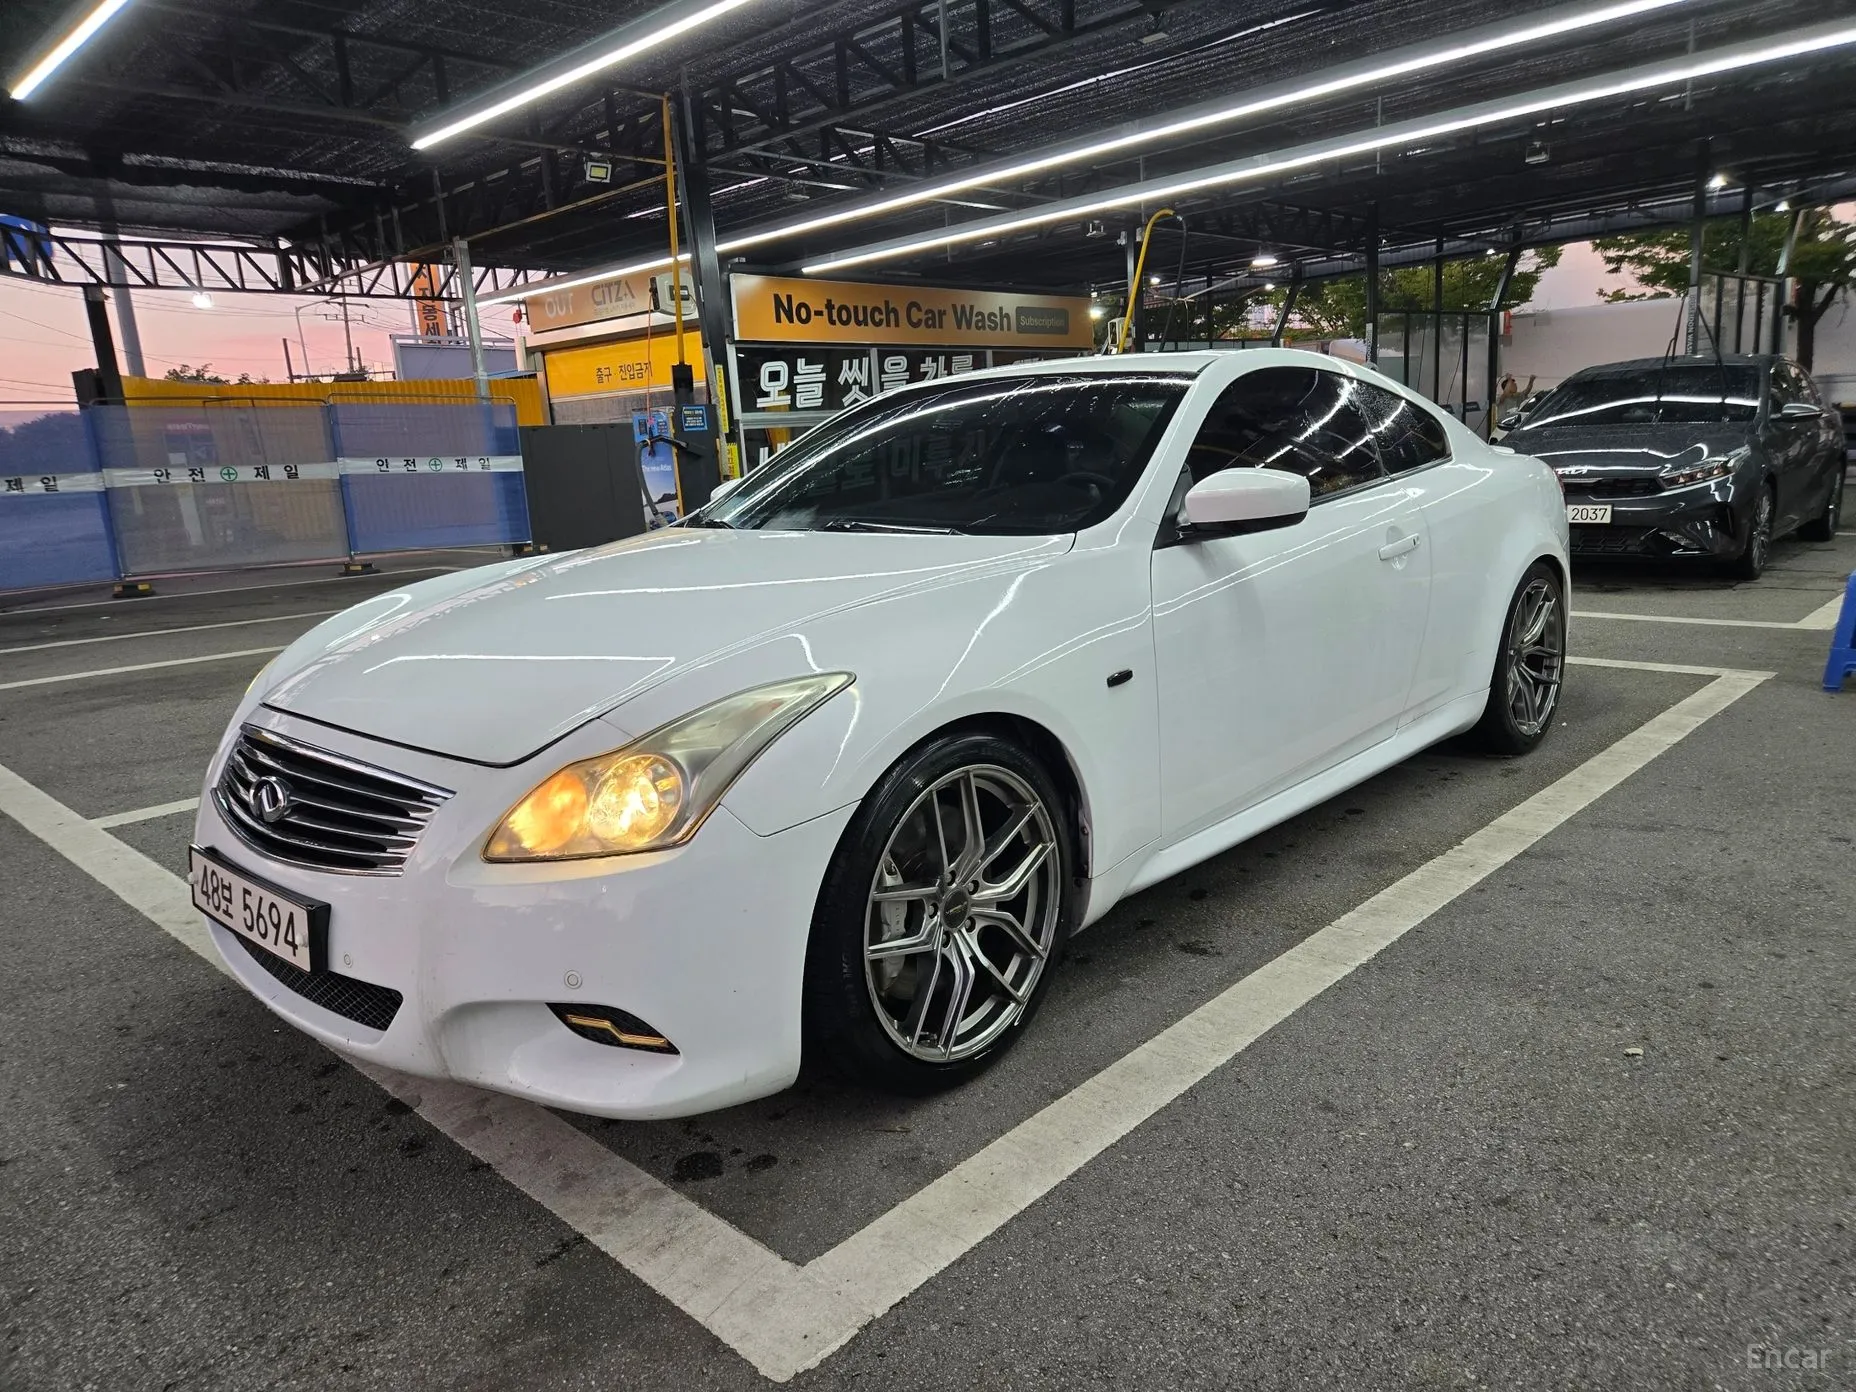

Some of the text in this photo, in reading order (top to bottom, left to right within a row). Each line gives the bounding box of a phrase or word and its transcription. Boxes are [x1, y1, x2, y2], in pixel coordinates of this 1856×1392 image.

[545, 292, 574, 319] OUT
[773, 293, 1012, 333] No-touch Car Wash
[1019, 315, 1066, 330] Subscription
[595, 367, 612, 384] 출구
[756, 357, 826, 409] 오늘
[4, 475, 60, 492] 제일
[153, 463, 300, 484] 안전 제일
[1571, 507, 1608, 521] 2037
[200, 864, 299, 957] 48보 5694
